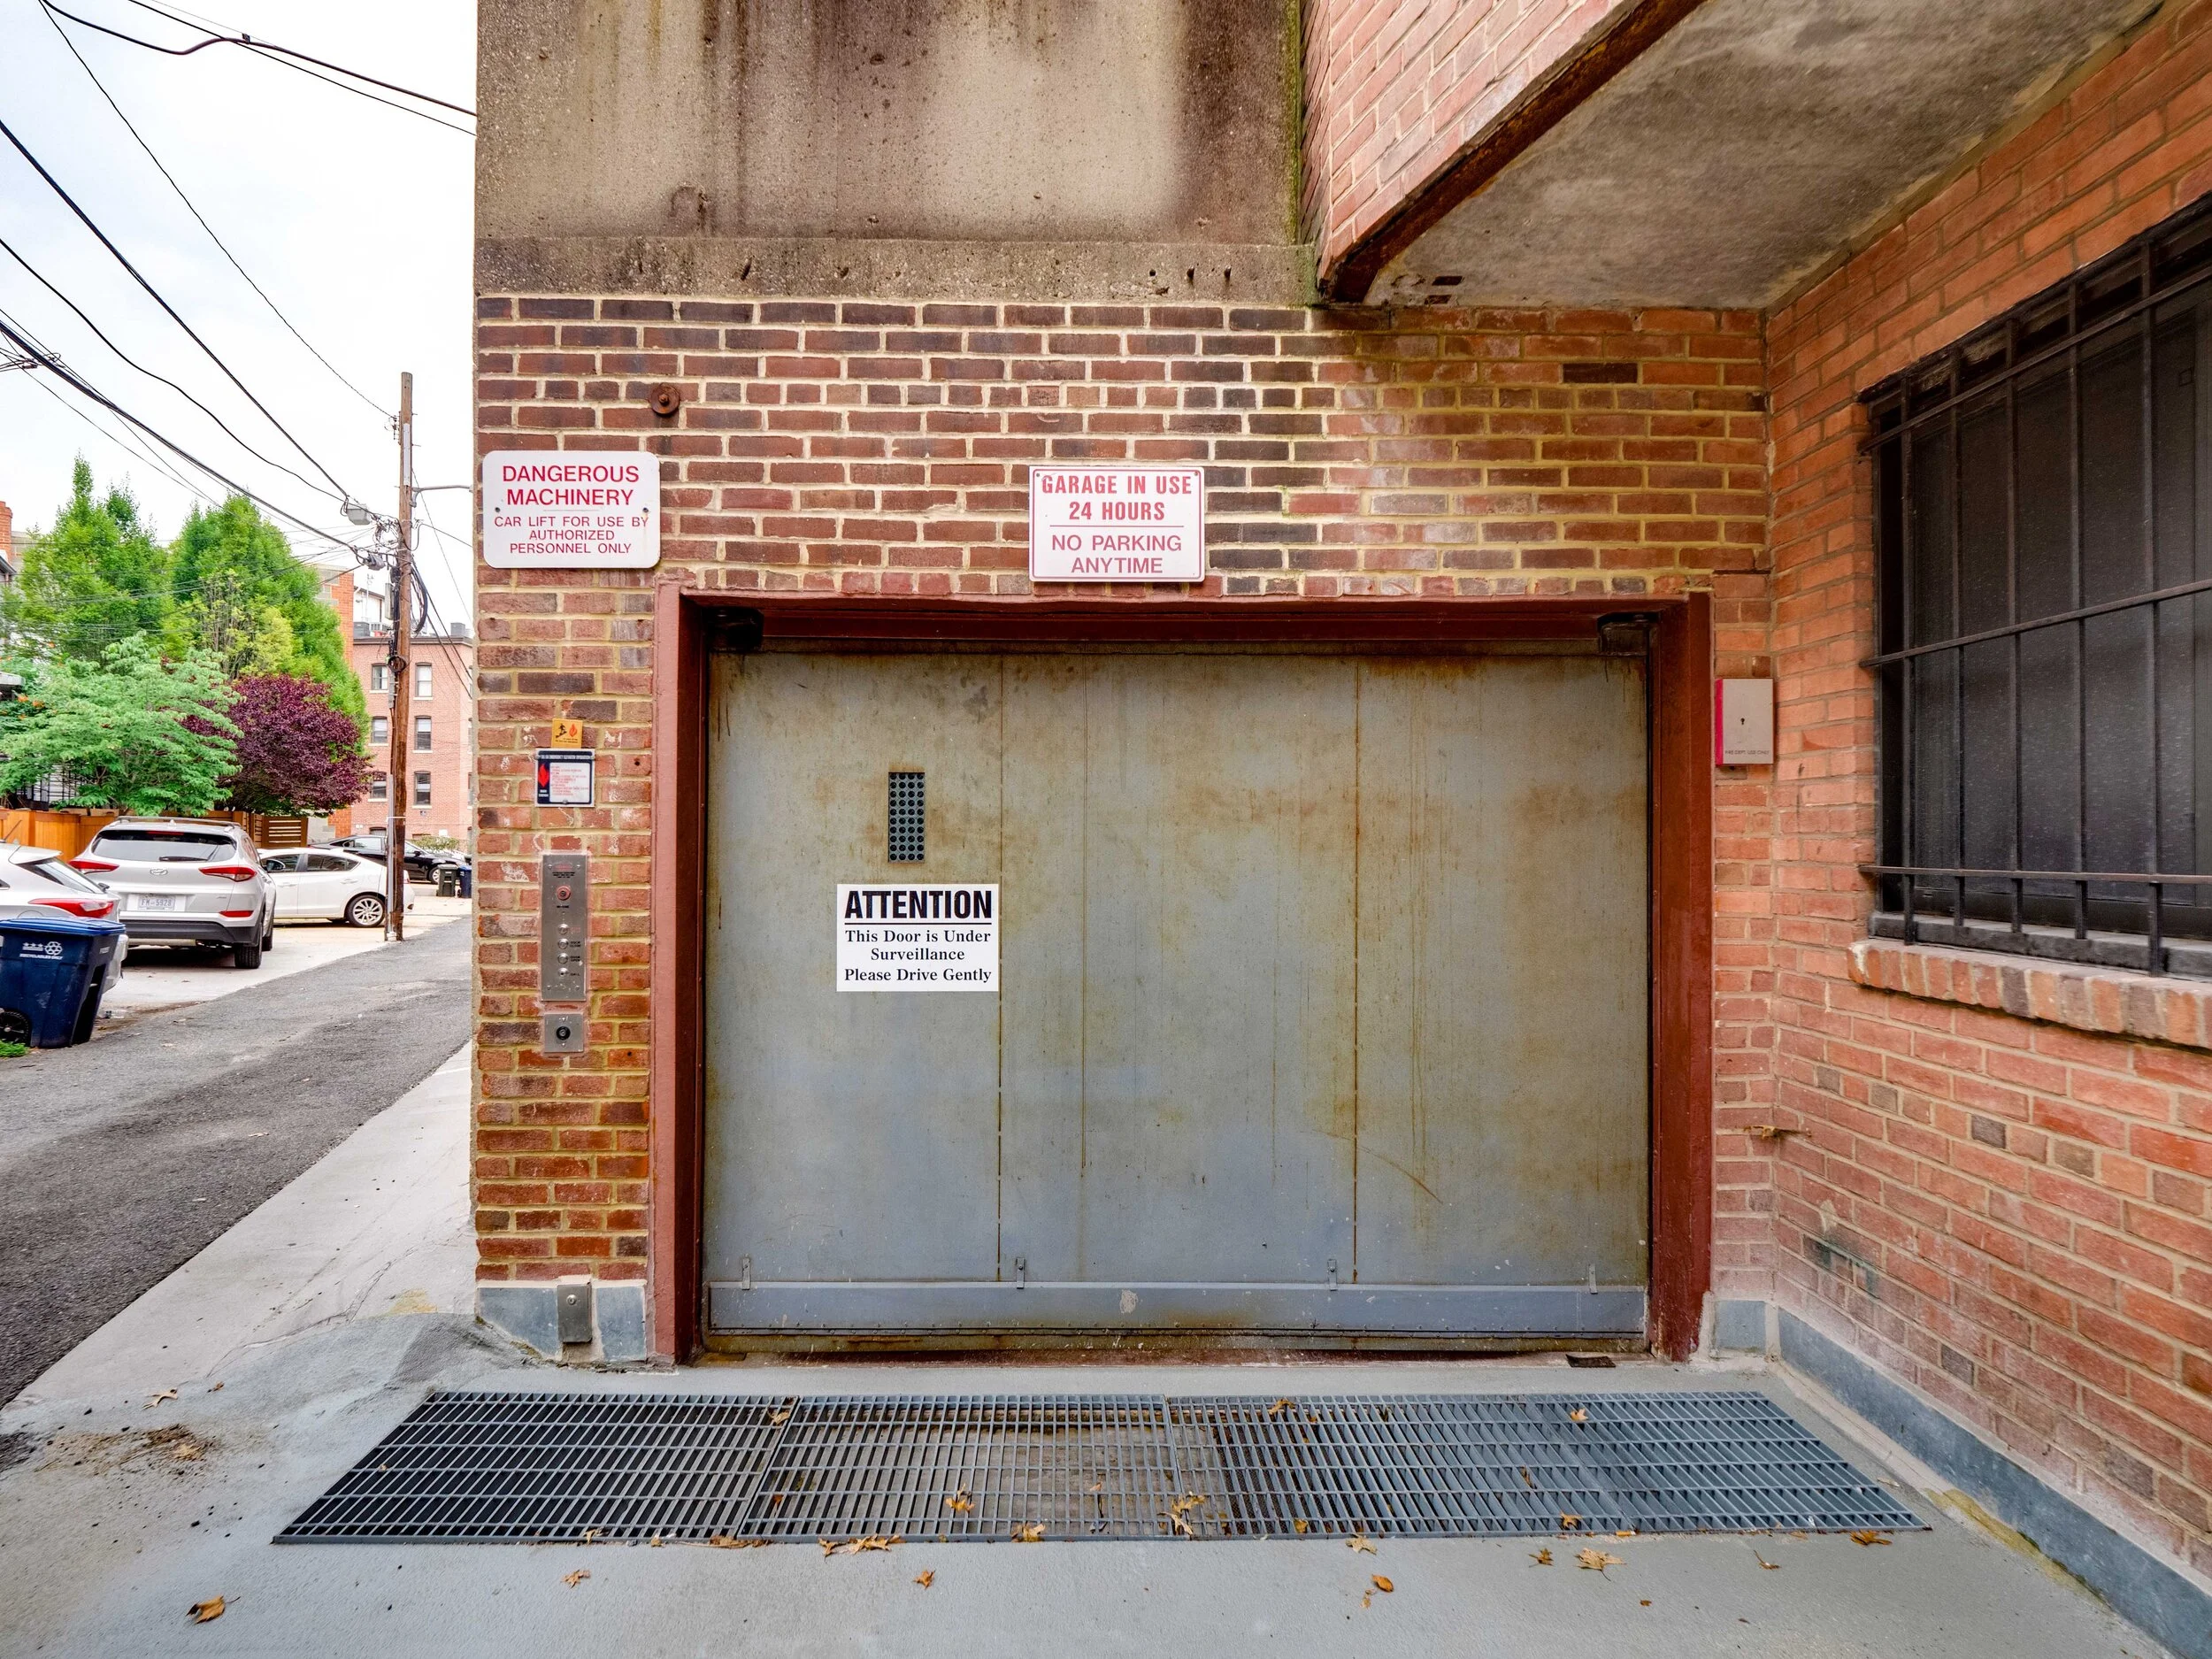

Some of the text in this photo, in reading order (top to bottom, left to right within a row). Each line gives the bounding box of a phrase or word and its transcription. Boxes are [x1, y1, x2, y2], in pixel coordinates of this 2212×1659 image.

[503, 465, 640, 482] DANGEROUS
[1041, 474, 1192, 495] GARAGE IN USE
[507, 488, 634, 505] MACHINERY
[1069, 501, 1165, 520] 24 HOURS
[494, 516, 649, 527] CAR LIFT FOR USE BY
[529, 530, 615, 541] AUTHORIZED
[1051, 534, 1182, 551] NO PARKING
[510, 543, 632, 554] PERSONNEL ONLY
[1071, 557, 1164, 573] ANYTIME
[844, 890, 992, 919] ATTENTION
[845, 930, 991, 942] This Door is Under
[871, 948, 965, 960] Surveillance
[845, 968, 992, 983] Please Drive Gently
